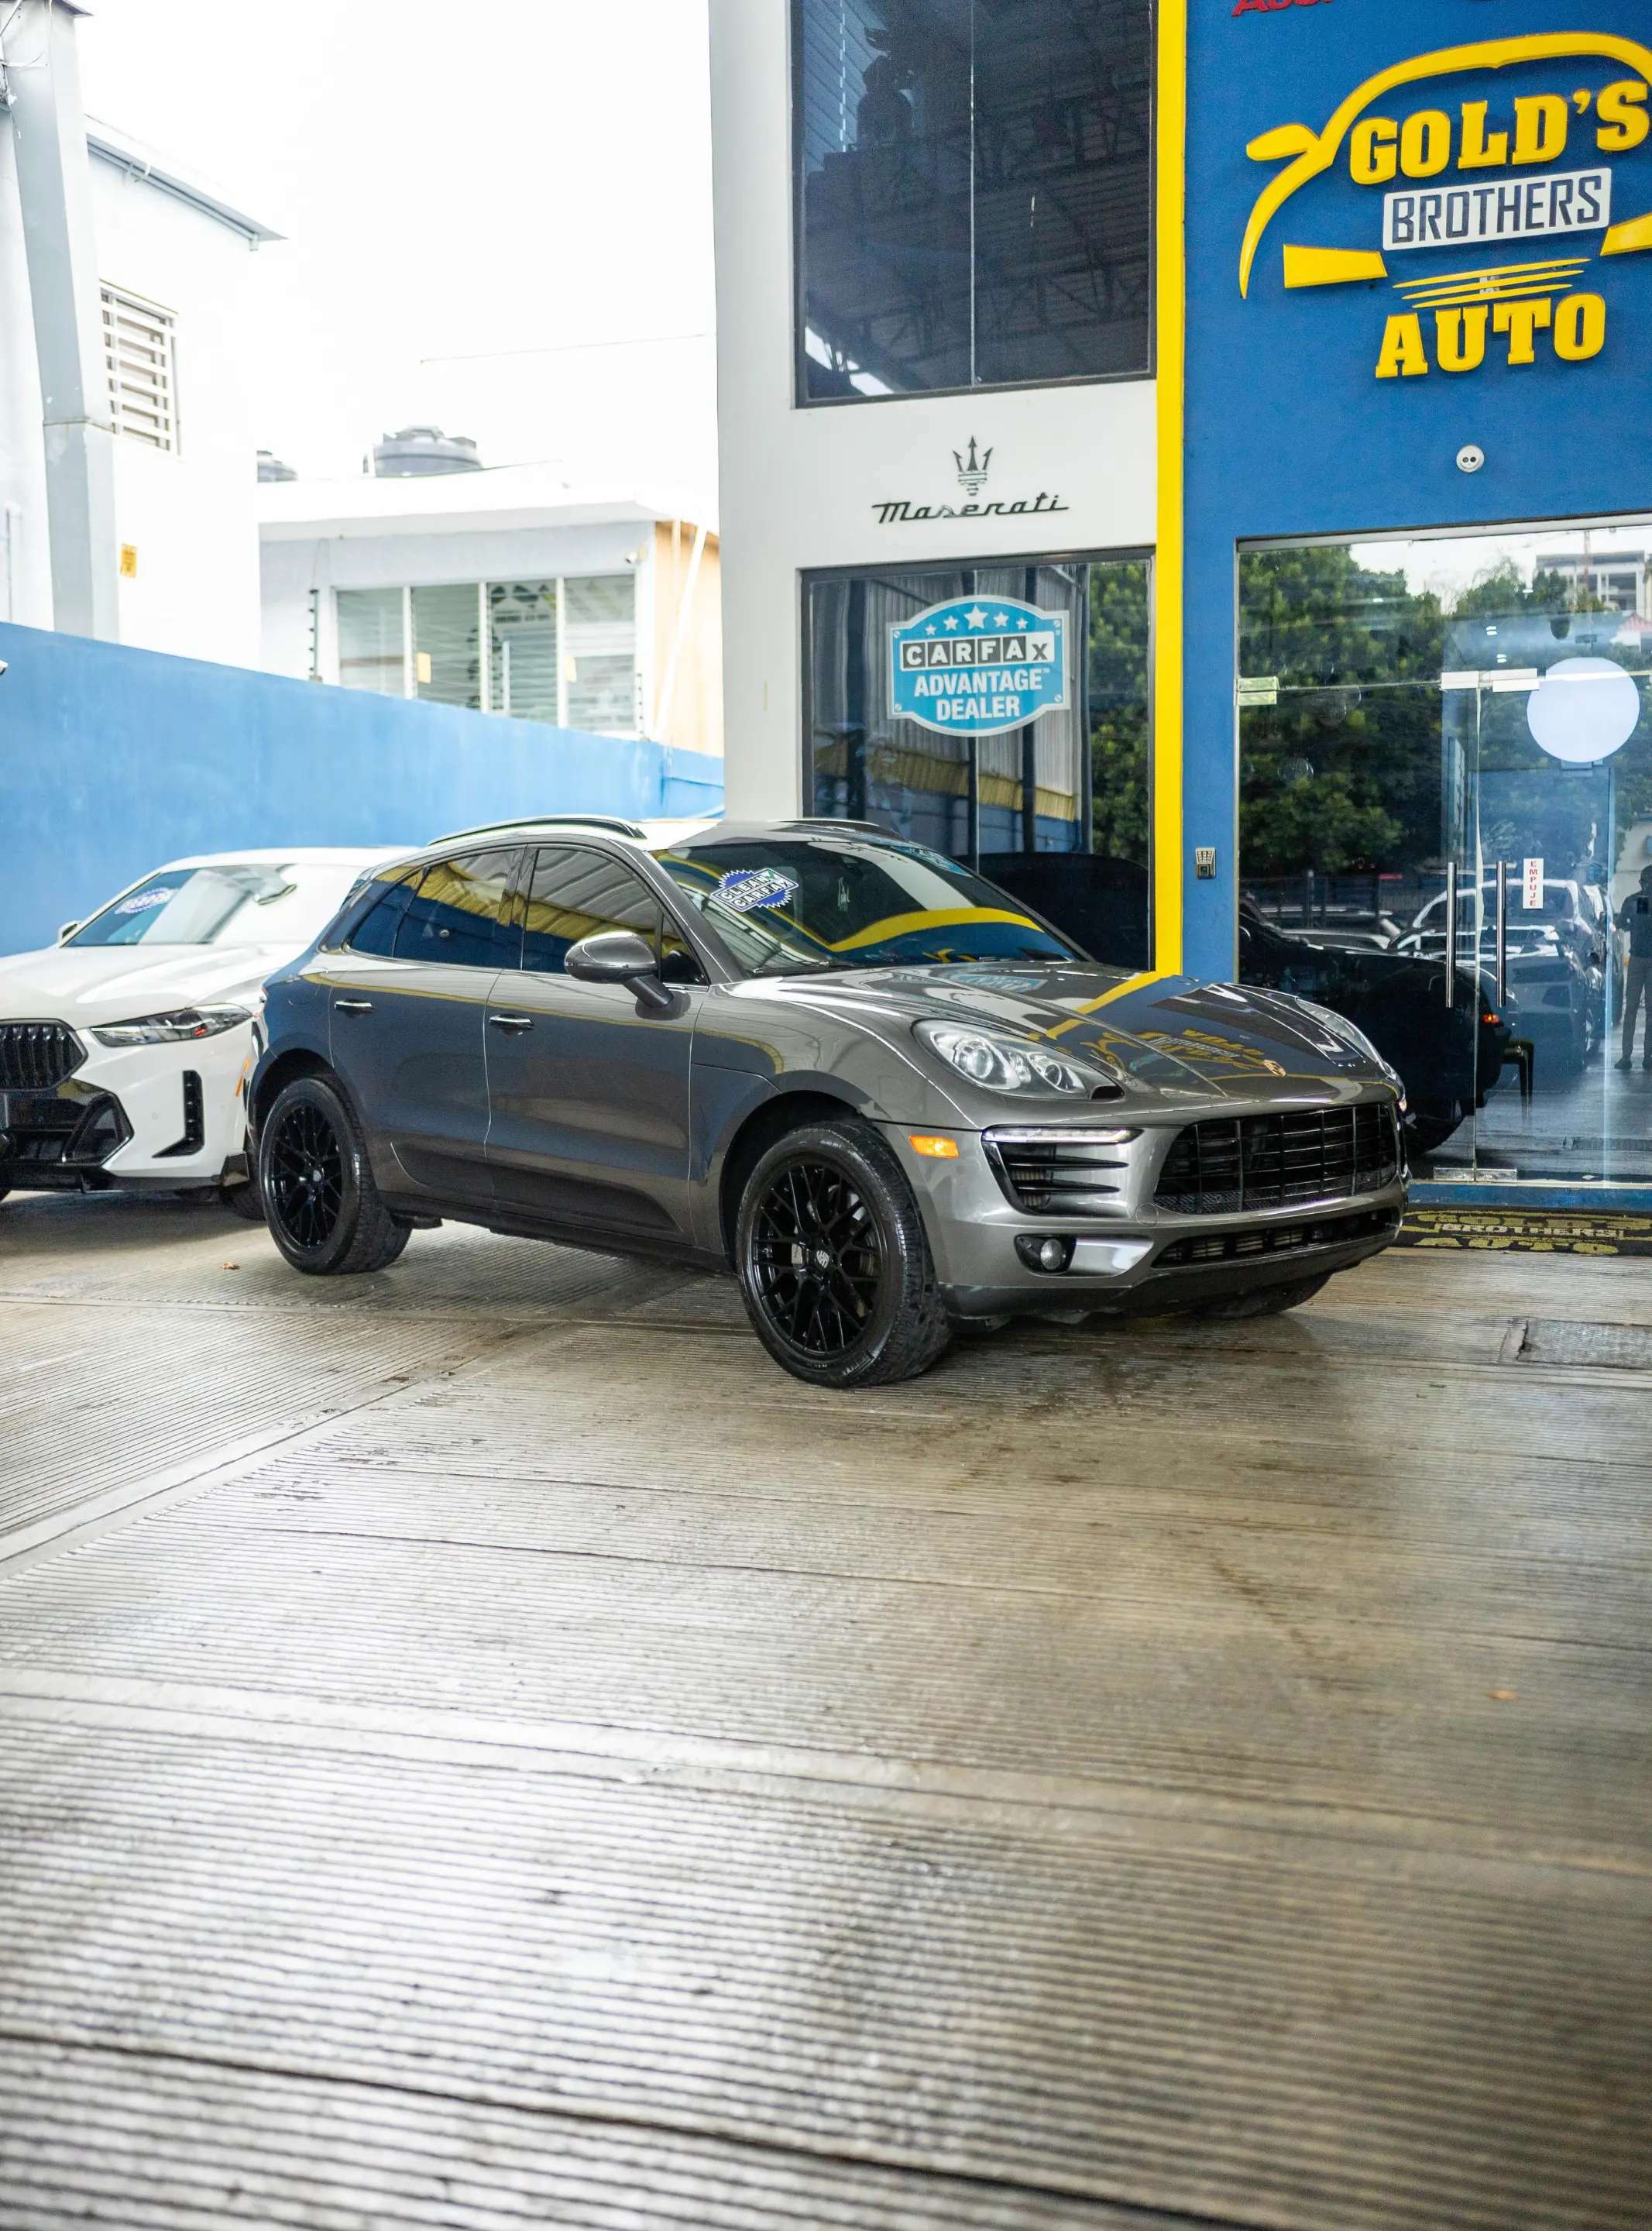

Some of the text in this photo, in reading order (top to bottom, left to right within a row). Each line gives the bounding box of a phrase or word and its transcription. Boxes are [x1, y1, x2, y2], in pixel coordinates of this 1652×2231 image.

[1349, 80, 1650, 185] GOLD'S
[1391, 175, 1602, 245] BROTHERS
[1376, 293, 1606, 379] AUTO
[871, 492, 1070, 524] Maserati
[905, 639, 1049, 666] CARFAX
[936, 696, 1021, 721] DEALER
[720, 873, 771, 899] CLEAN
[733, 881, 790, 907] CARFAX
[1529, 861, 1538, 906] EMPUJE
[1441, 1223, 1618, 1238] BROTHERS
